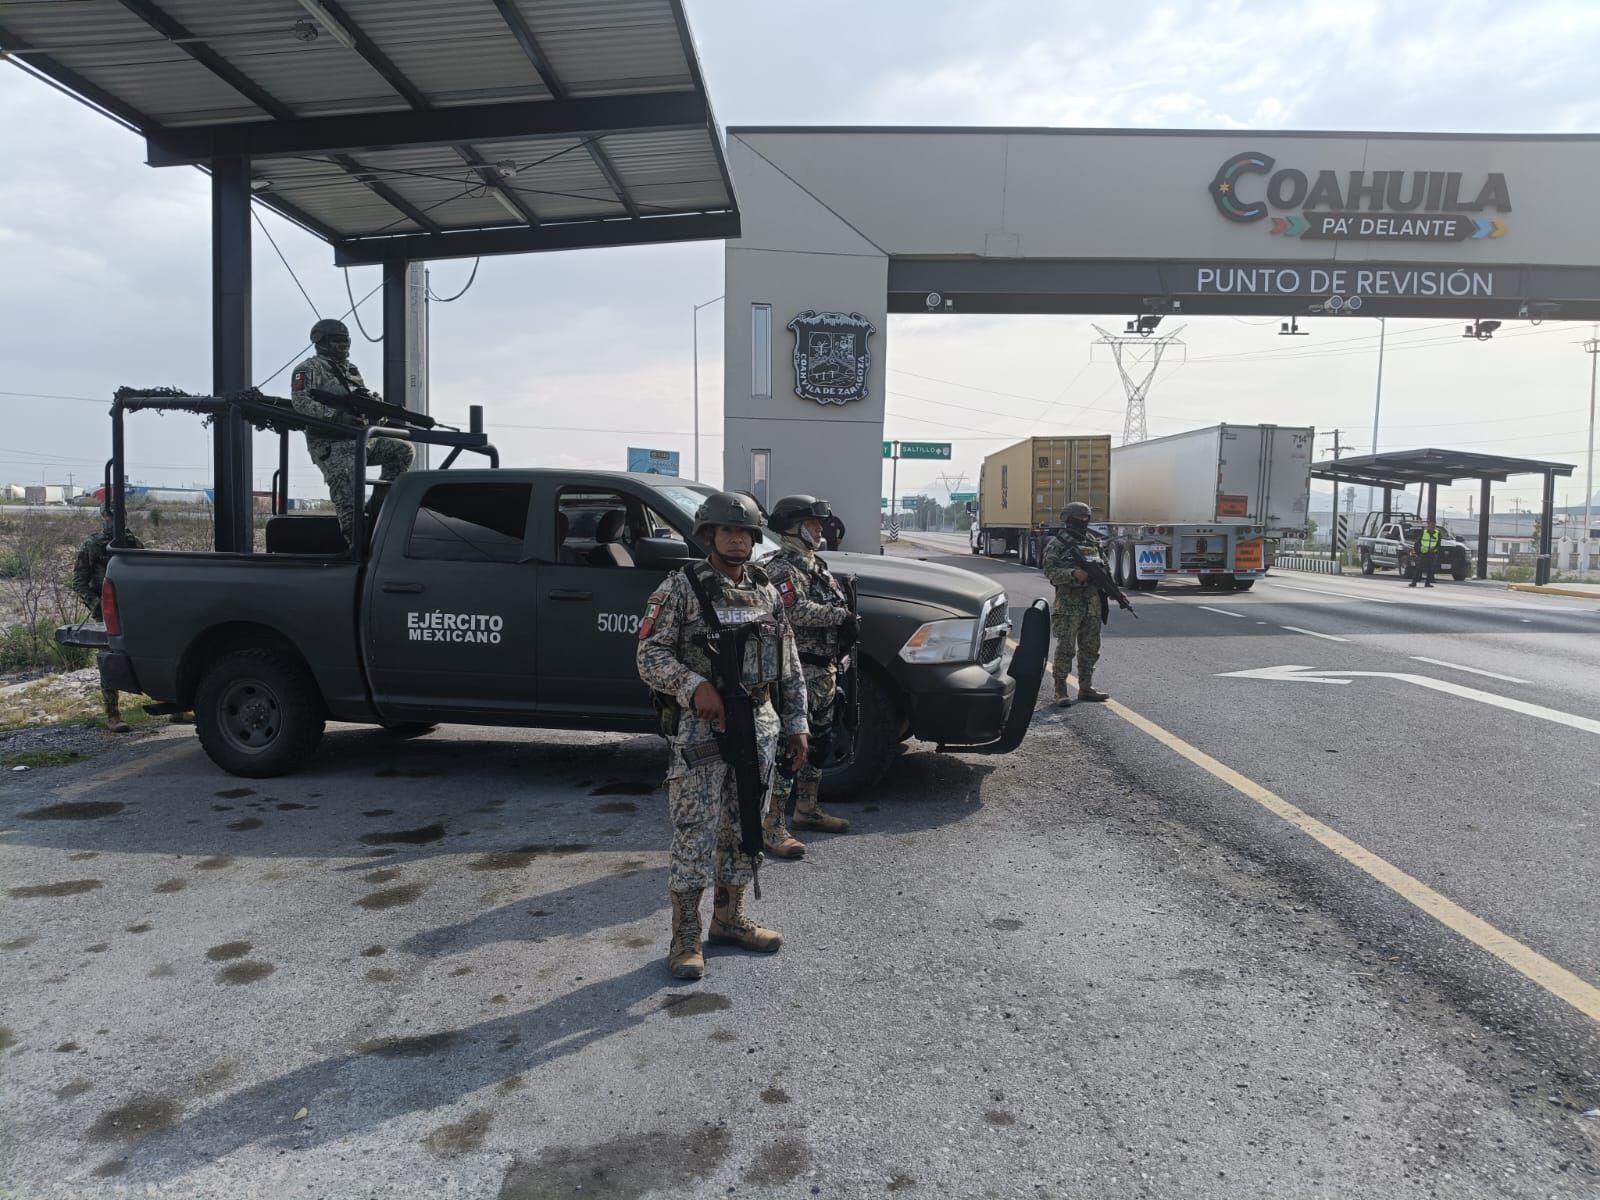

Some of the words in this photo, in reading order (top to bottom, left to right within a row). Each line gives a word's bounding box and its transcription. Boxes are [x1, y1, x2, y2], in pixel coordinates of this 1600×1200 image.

[1208, 151, 1512, 222] COAHUILA
[1360, 218, 1457, 236] DELANTE
[1198, 268, 1300, 293] PUNTO
[1310, 269, 1347, 294] DE
[1357, 268, 1493, 296] REVISIÓN
[822, 387, 836, 395] DE
[902, 446, 936, 454] SALTILLO
[407, 609, 503, 631] EJÉRCITO
[598, 613, 645, 634] 5003
[409, 629, 501, 644] MEXICANO
